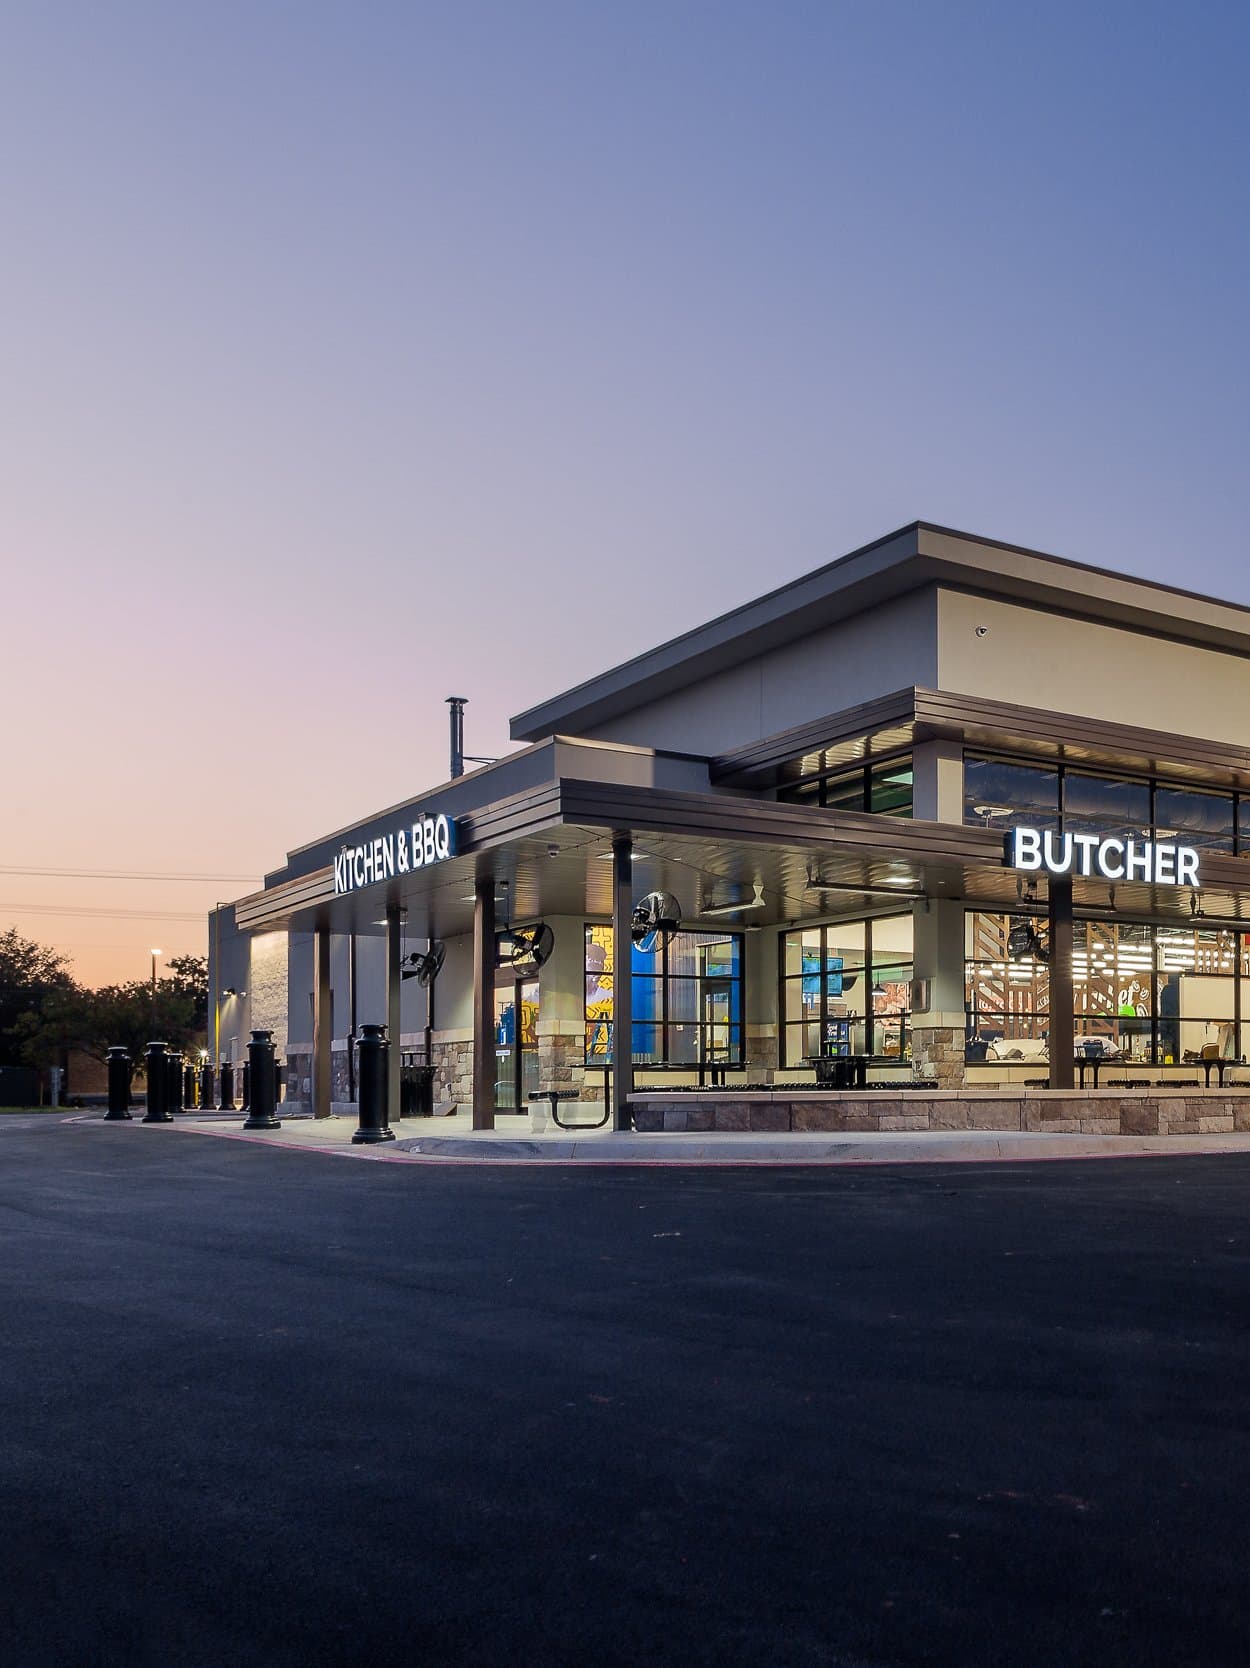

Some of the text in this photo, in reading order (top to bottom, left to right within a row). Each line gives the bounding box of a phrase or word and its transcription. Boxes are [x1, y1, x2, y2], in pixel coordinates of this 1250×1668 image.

[334, 813, 451, 894] KITCHEN & BBQ
[1014, 826, 1200, 888] BUTCHER
